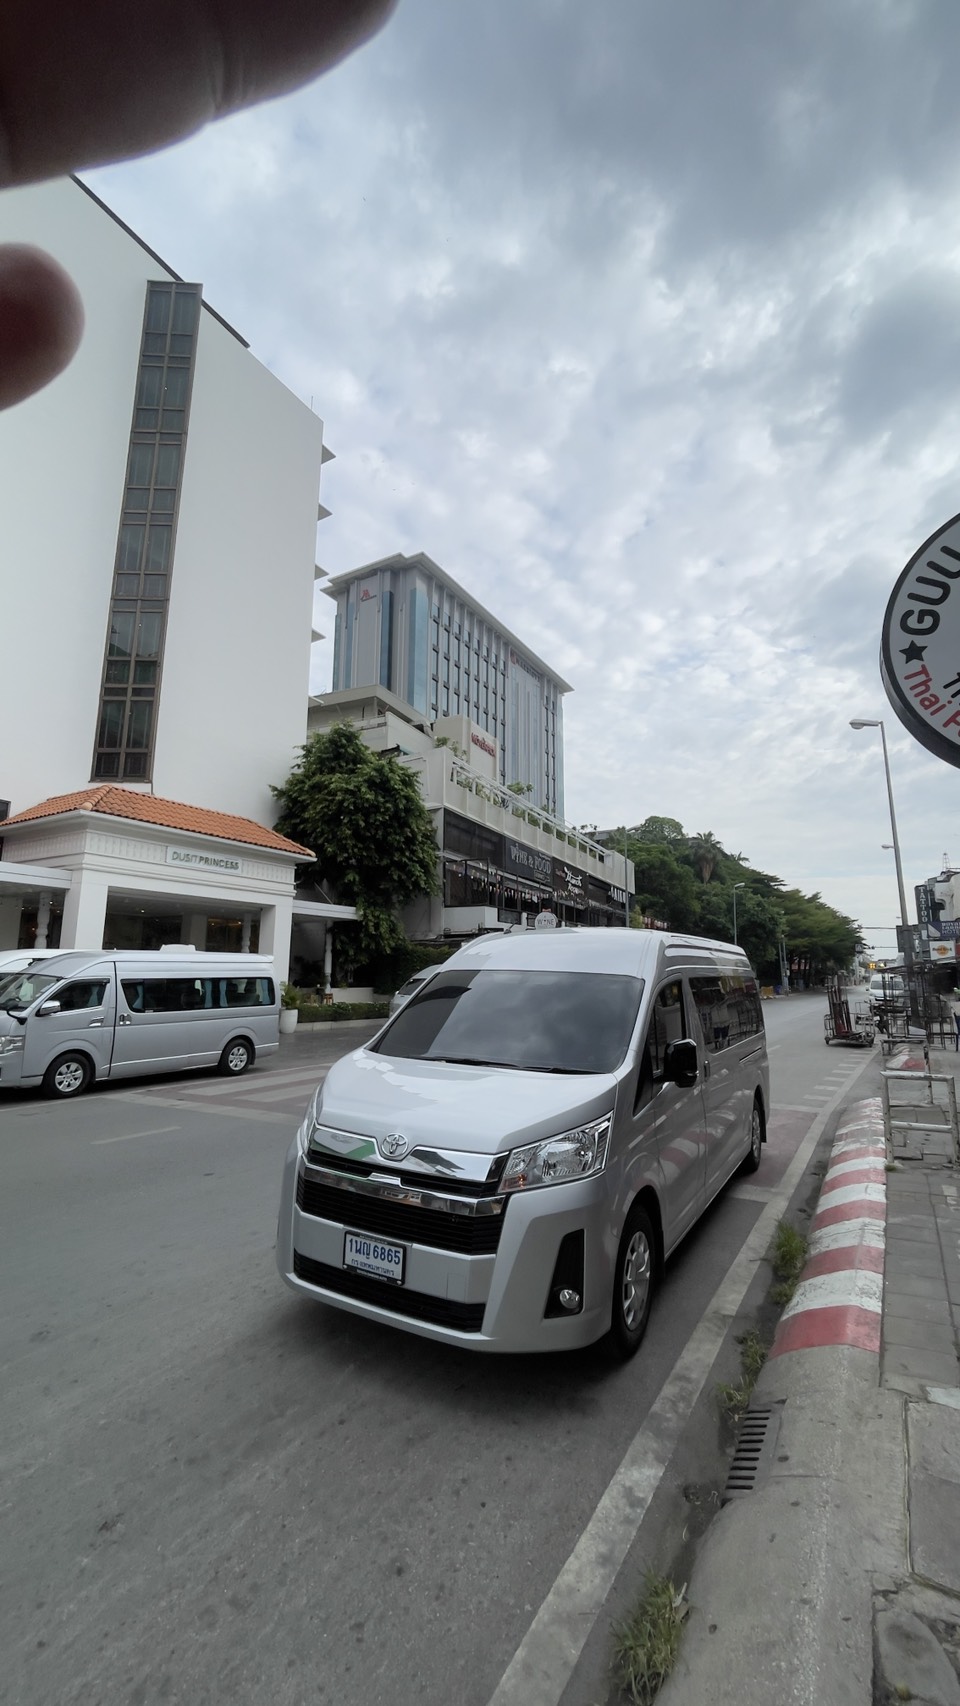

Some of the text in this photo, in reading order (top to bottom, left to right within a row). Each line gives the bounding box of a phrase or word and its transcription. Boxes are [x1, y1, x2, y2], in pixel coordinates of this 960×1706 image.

[904, 664, 952, 716] Thai
[534, 856, 551, 874] FOOD
[918, 886, 928, 923] TATTOO
[373, 1244, 401, 1266] 6865
